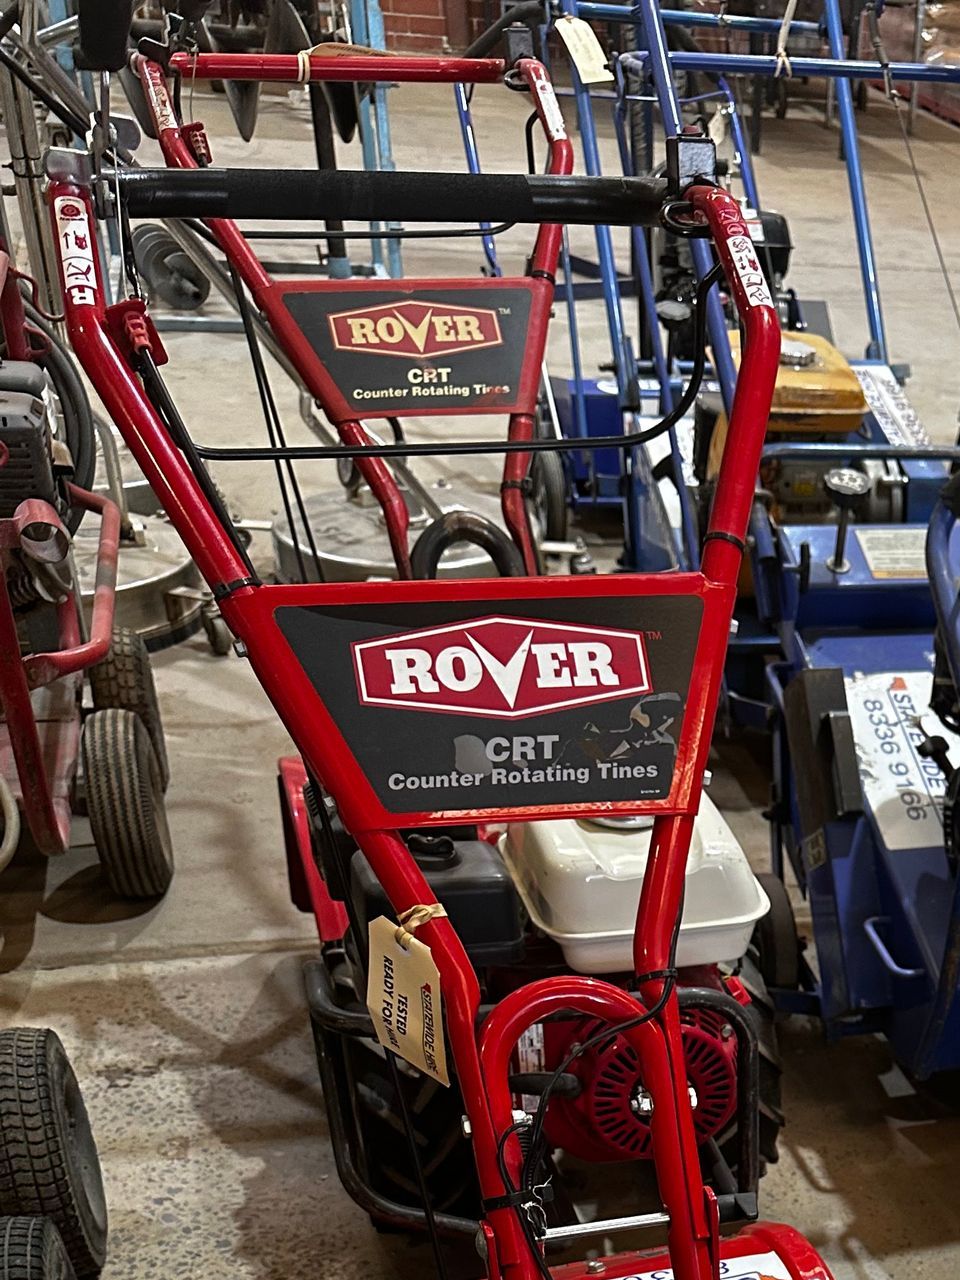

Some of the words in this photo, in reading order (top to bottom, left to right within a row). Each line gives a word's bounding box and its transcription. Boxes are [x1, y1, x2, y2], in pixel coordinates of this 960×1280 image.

[347, 308, 485, 353] ROVER
[407, 368, 452, 384] CRT
[353, 386, 408, 400] Counter
[411, 385, 470, 397] Rotating
[646, 631, 662, 640] TM
[385, 629, 620, 709] ROVER
[485, 735, 559, 762] CRT
[864, 699, 900, 755] 8336
[888, 762, 927, 822] 9166
[388, 771, 484, 790] Counter
[491, 764, 590, 784] Rotating
[597, 762, 658, 780] Tines
[383, 955, 394, 998] READY
[382, 1000, 393, 1027] FOR
[396, 993, 408, 1036] TESTED
[423, 991, 436, 1051] STATEWIDE
[384, 1026, 400, 1049] HIRE
